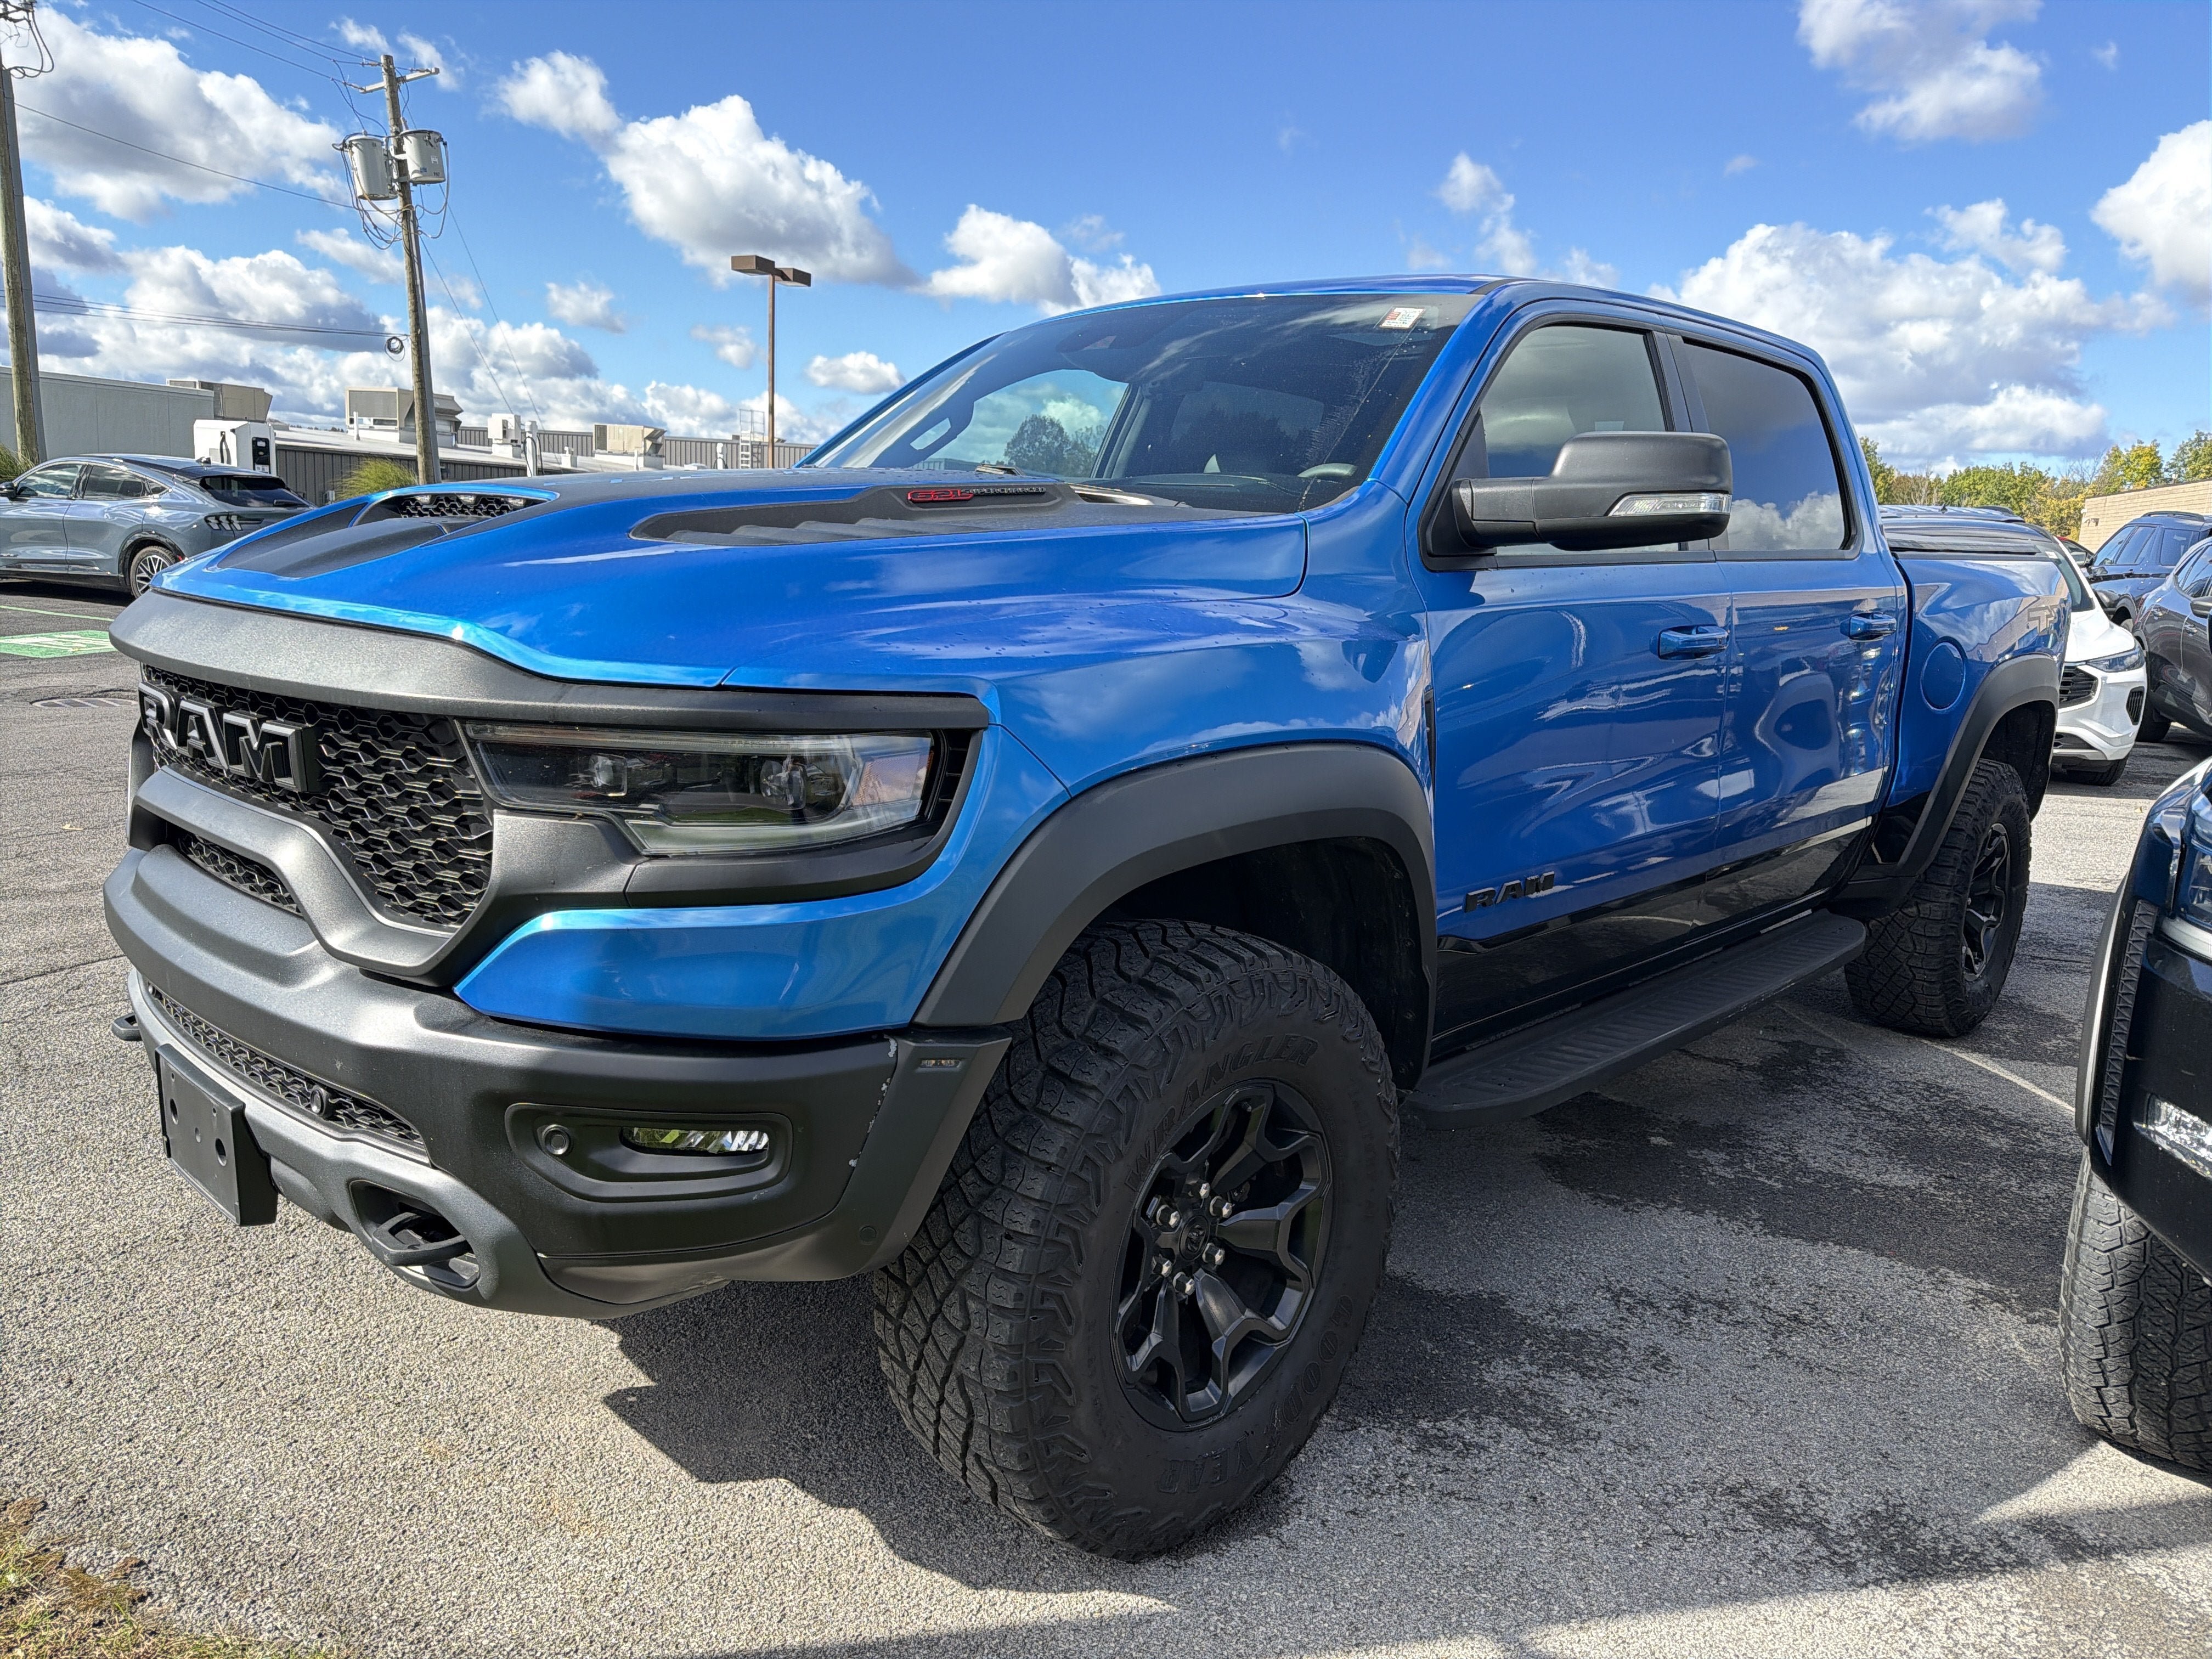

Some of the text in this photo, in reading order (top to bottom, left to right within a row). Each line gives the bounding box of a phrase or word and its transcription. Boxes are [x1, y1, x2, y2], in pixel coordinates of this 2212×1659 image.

[138, 681, 314, 793] RAM
[1464, 871, 1555, 913] RAM
[1124, 1034, 1319, 1192] WRANGLER
